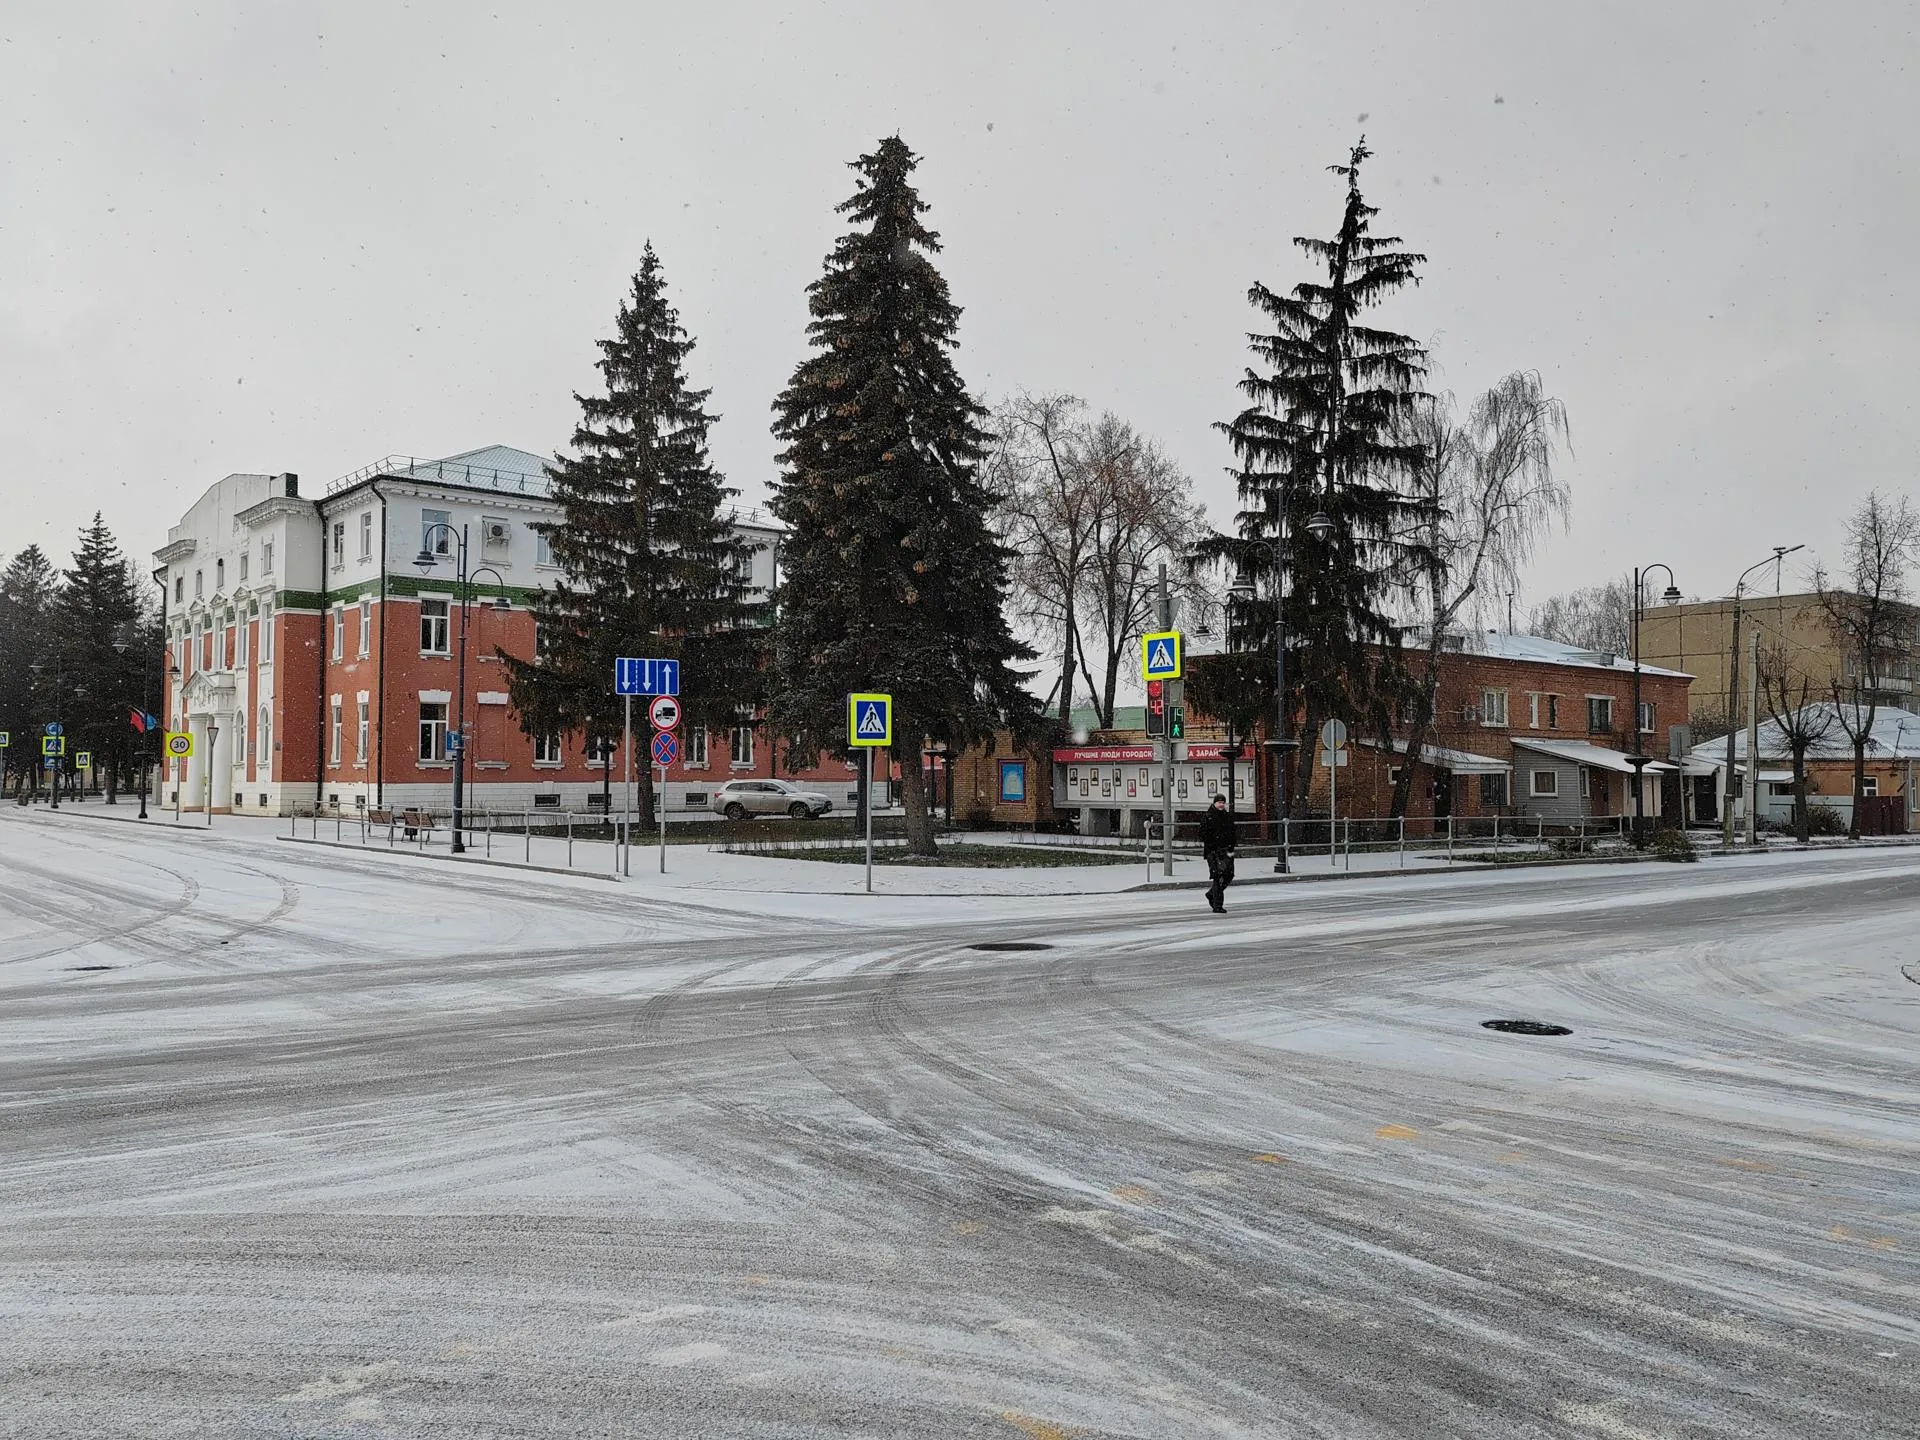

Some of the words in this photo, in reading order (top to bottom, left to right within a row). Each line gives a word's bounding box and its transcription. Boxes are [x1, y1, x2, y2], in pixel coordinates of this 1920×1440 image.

[1151, 699, 1163, 715] 42
[1174, 707, 1184, 722] 19
[173, 741, 186, 749] 30
[1100, 751, 1121, 759] ЛЮДИ
[1122, 750, 1153, 758] ГОРОДСК
[1196, 748, 1220, 757] ЗАРАЙ
